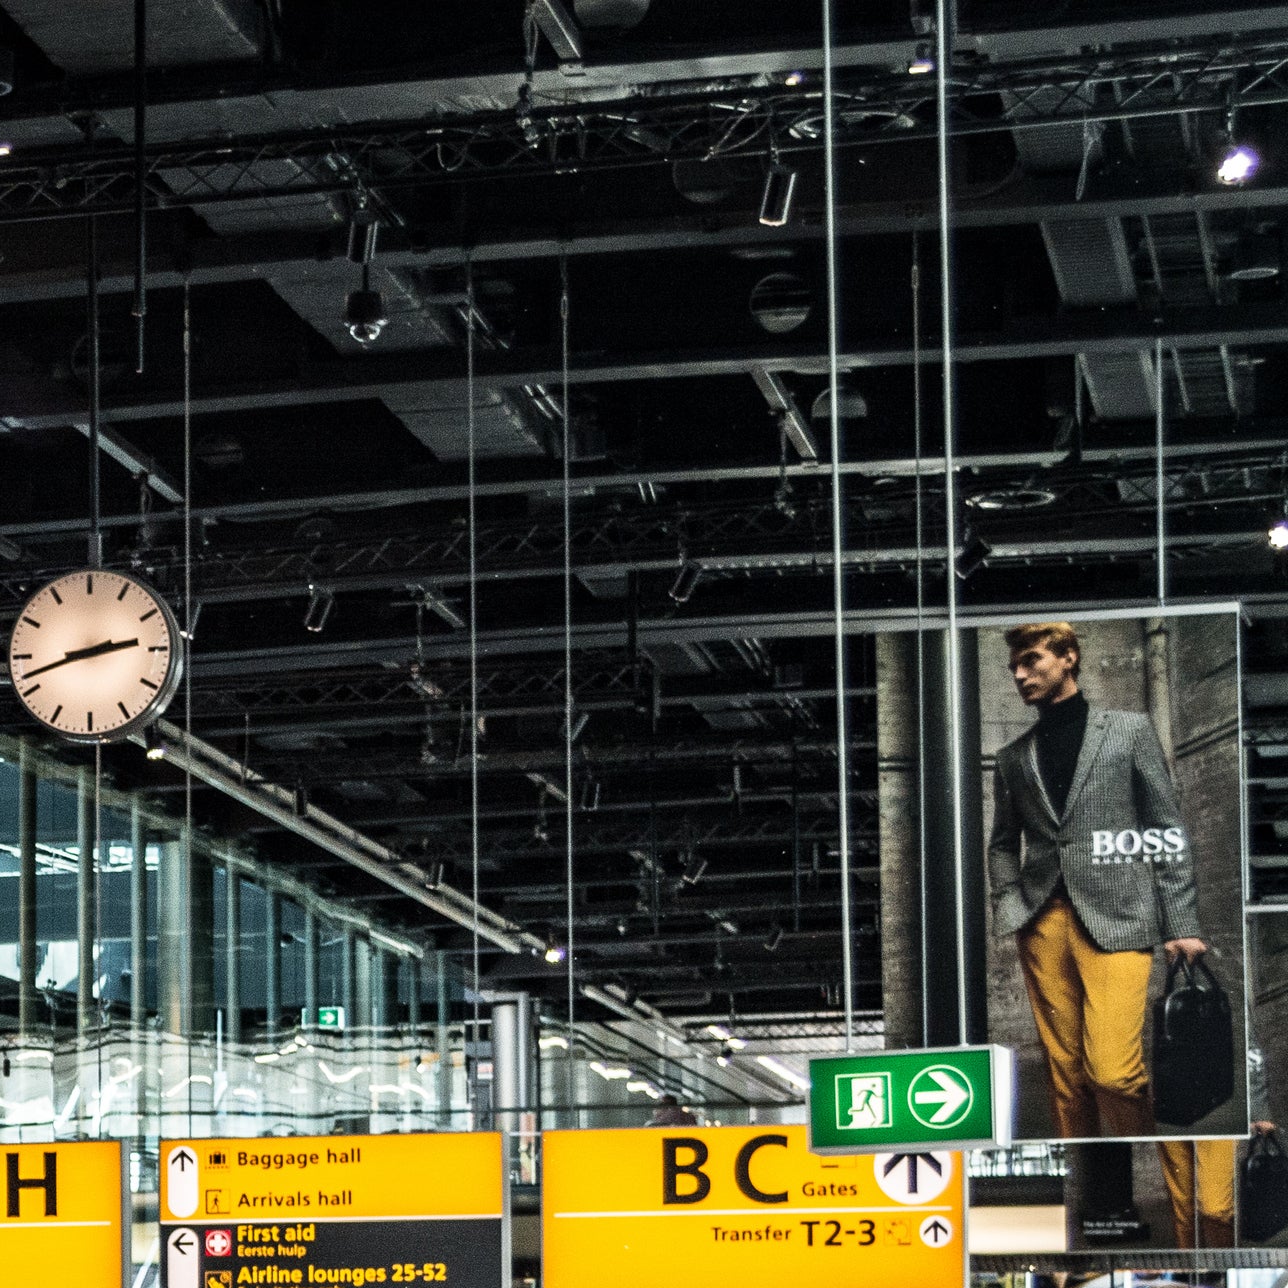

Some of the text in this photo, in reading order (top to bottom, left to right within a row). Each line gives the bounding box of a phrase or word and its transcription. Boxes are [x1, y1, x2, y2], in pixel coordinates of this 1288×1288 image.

[1092, 827, 1185, 856] BOSS
[237, 1148, 362, 1169] Baggage hall
[237, 1189, 353, 1209] Arrivals hall
[802, 1181, 858, 1197] Gates
[236, 1223, 316, 1242] First aid
[711, 1219, 876, 1246] Transfer T2-3
[236, 1244, 307, 1258] Eerste hulp
[236, 1263, 448, 1287] Airline lounges 25-52
